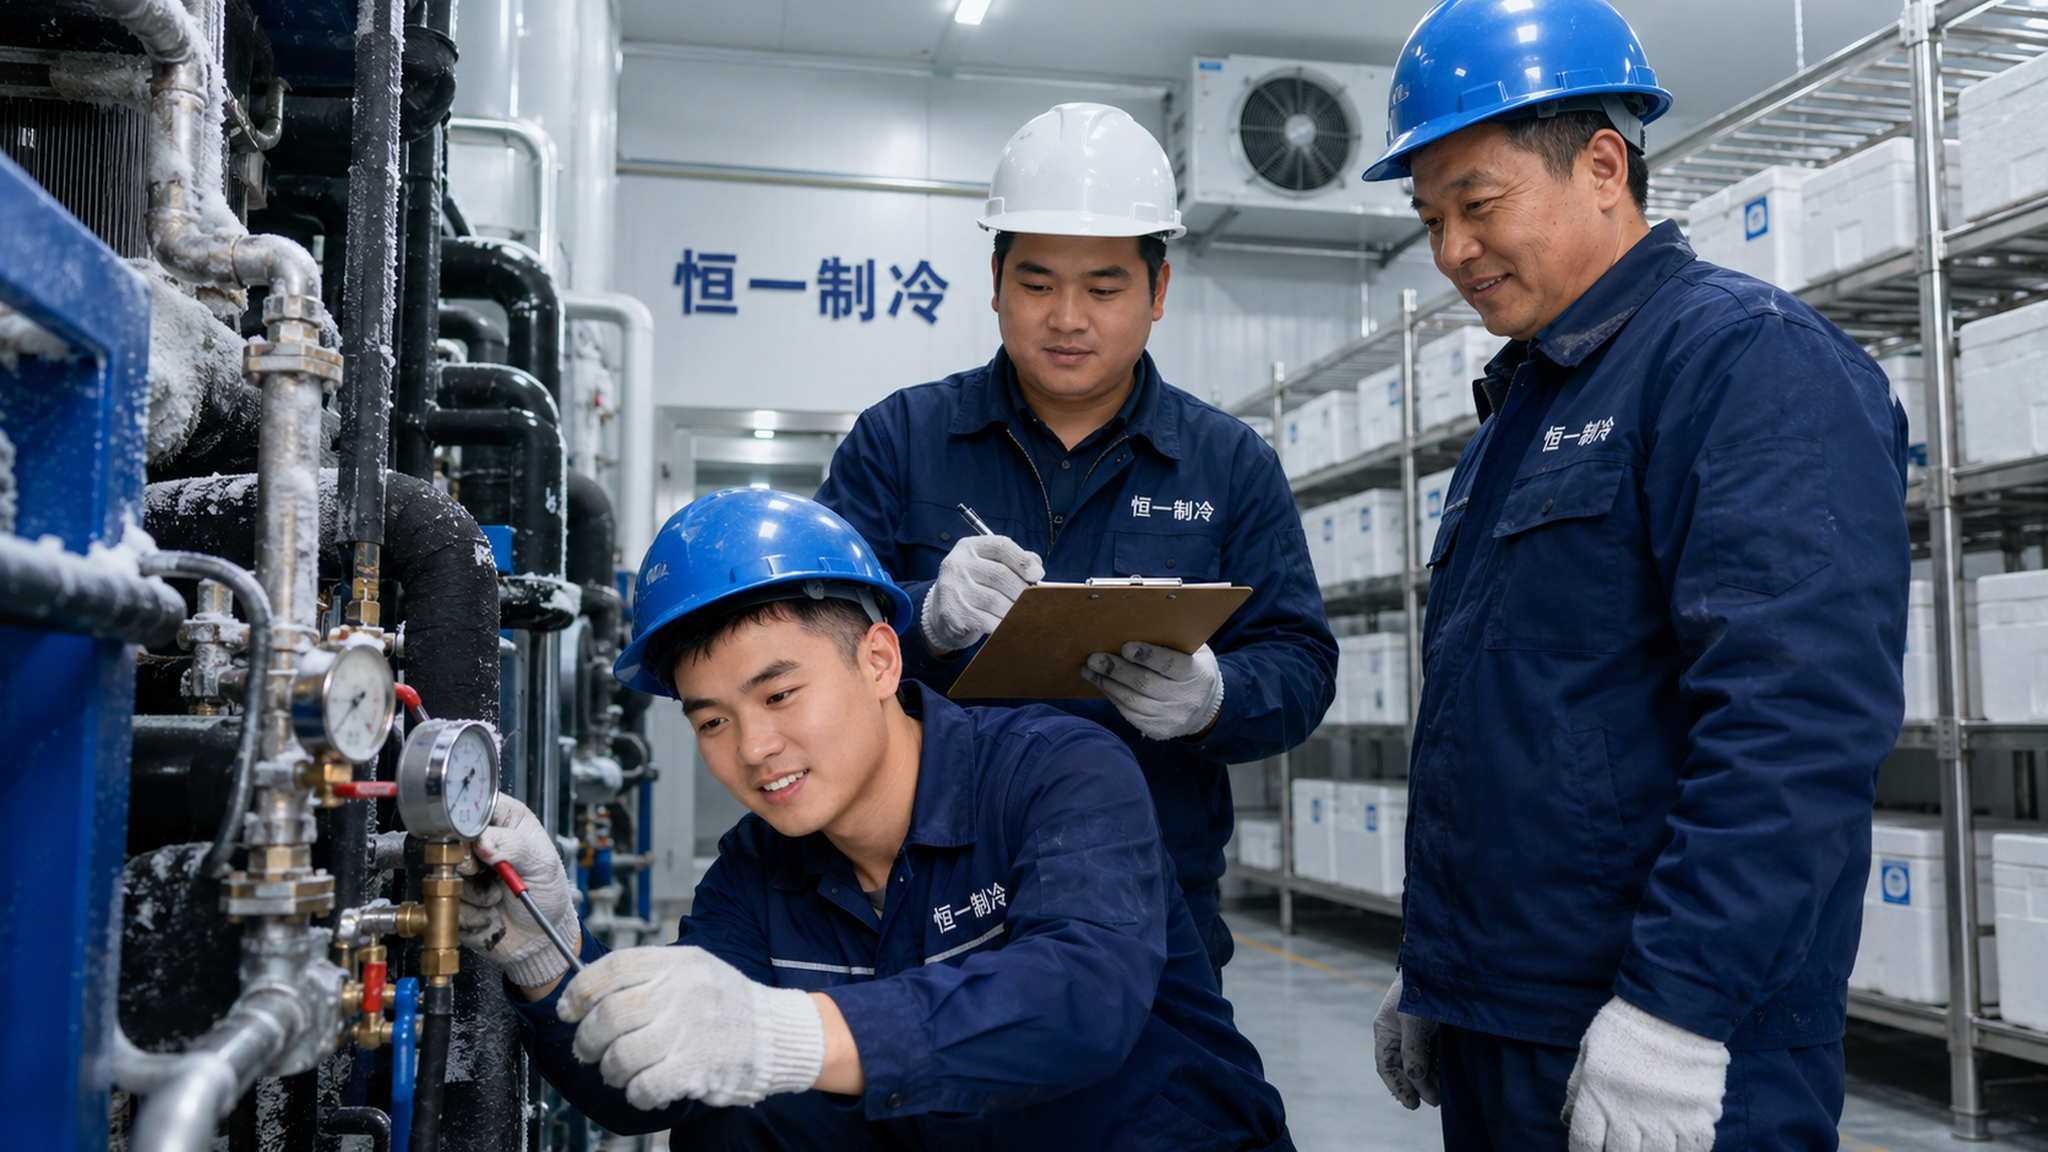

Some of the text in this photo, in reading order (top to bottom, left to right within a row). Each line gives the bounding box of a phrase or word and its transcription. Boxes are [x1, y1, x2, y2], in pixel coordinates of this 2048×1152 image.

[673, 249, 949, 325] 恒一制冷
[1542, 416, 1614, 452] 恒一制冷
[1131, 495, 1214, 522] 恒一制冷
[933, 882, 1006, 934] 恒一制冷
